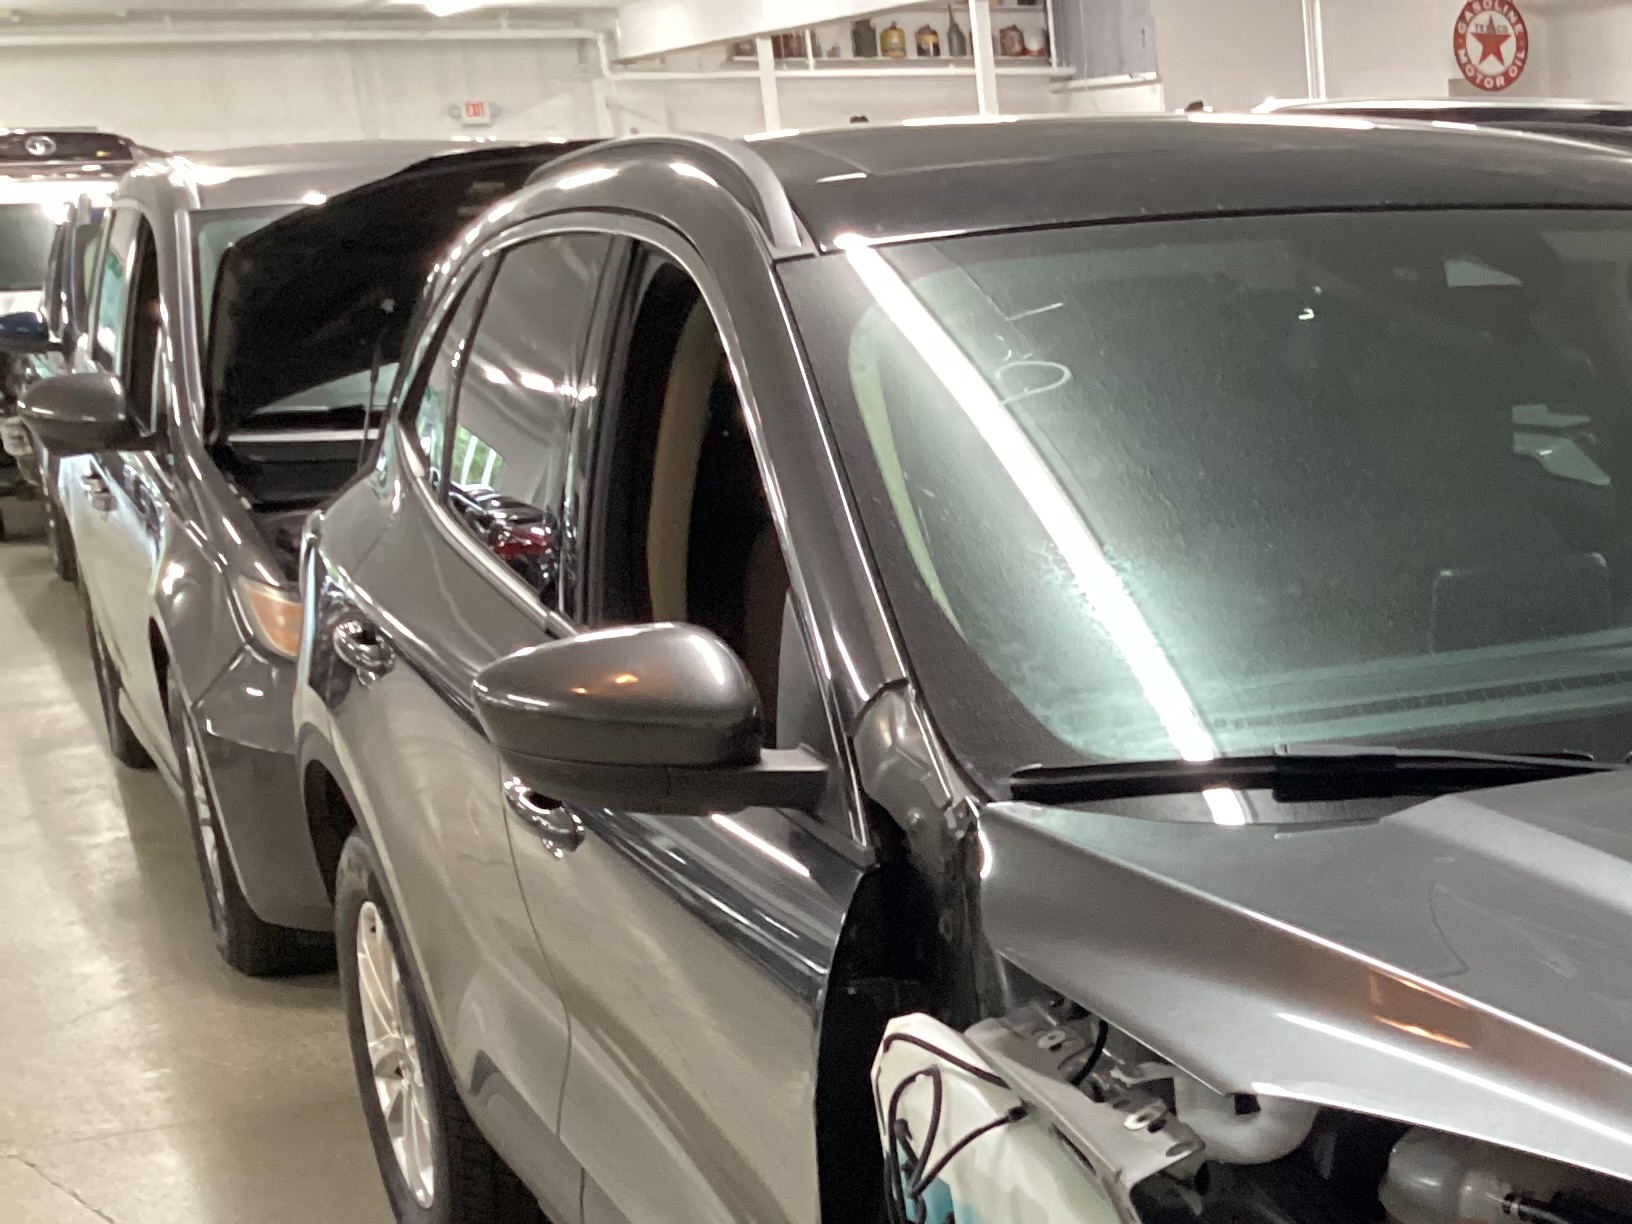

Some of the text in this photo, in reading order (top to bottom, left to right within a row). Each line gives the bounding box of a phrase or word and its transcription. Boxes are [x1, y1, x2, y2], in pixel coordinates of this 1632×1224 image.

[1458, 0, 1524, 34] GASOLINE
[1474, 23, 1509, 34] TECO
[1457, 48, 1525, 88] MOTOR OIL
